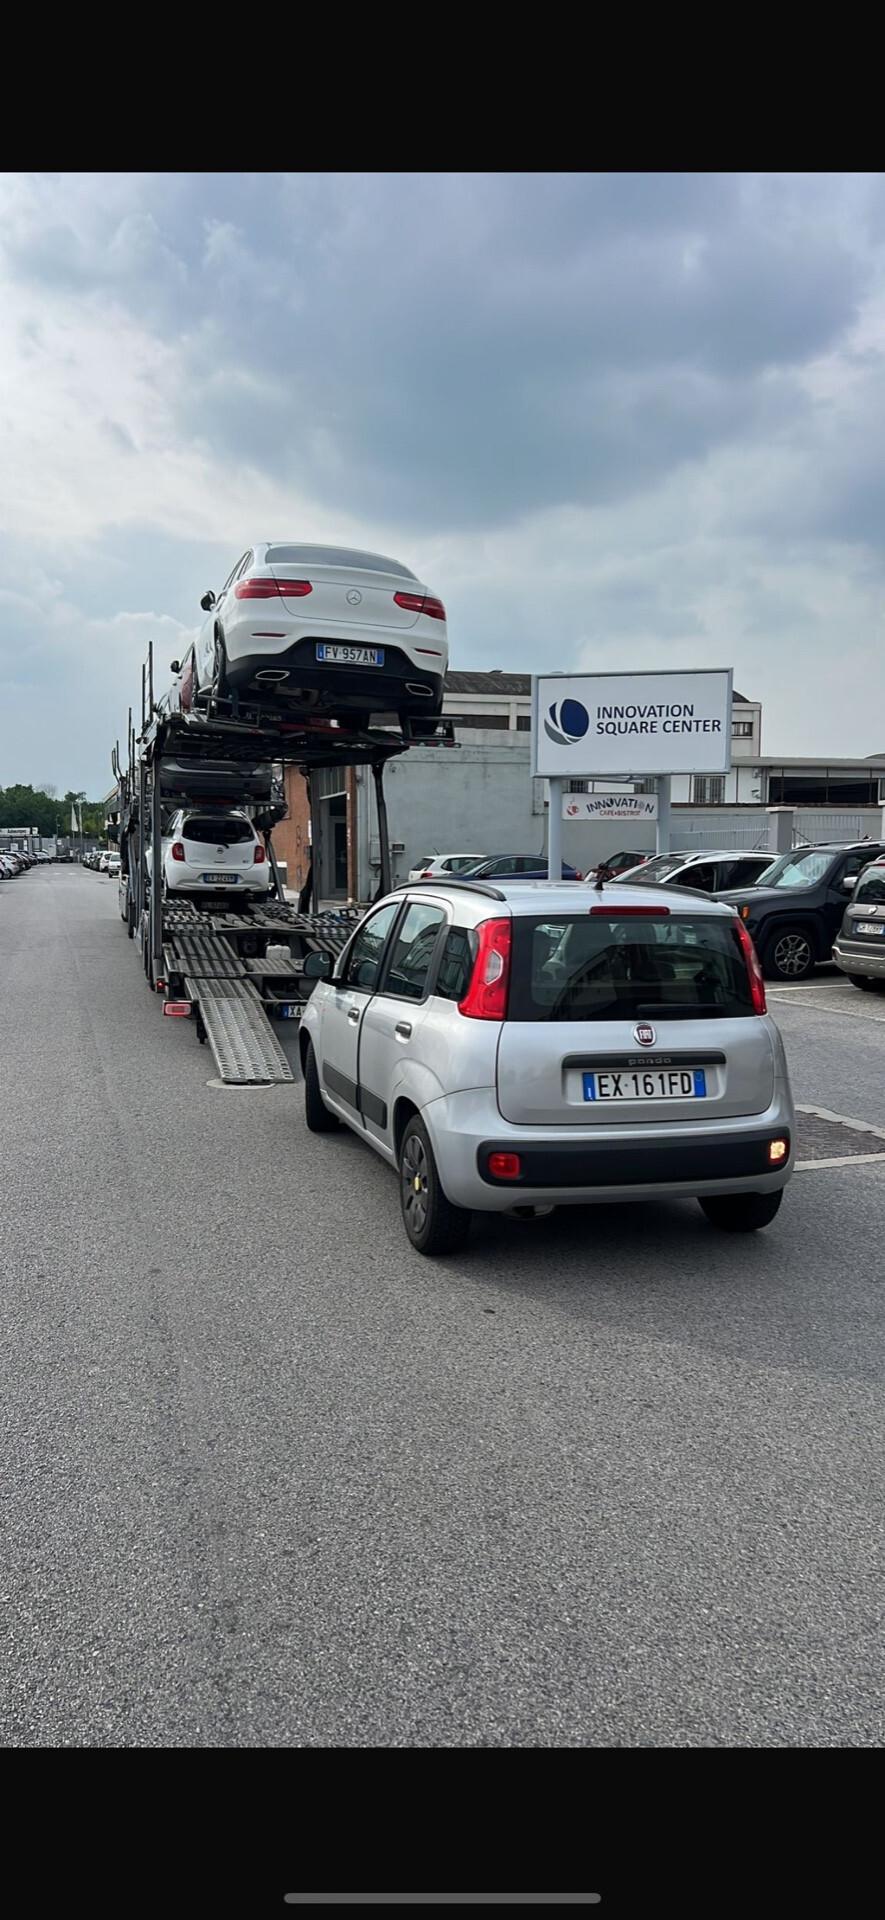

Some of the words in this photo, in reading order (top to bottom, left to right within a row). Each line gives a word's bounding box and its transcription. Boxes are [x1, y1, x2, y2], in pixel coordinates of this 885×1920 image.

[325, 646, 338, 659] FV
[597, 704, 695, 719] INNOVATION
[596, 721, 658, 736] SQUARE
[662, 719, 722, 733] CENTER
[638, 1029, 652, 1040] FIAT
[628, 1056, 672, 1066] panda
[632, 1072, 692, 1097] 161FD
